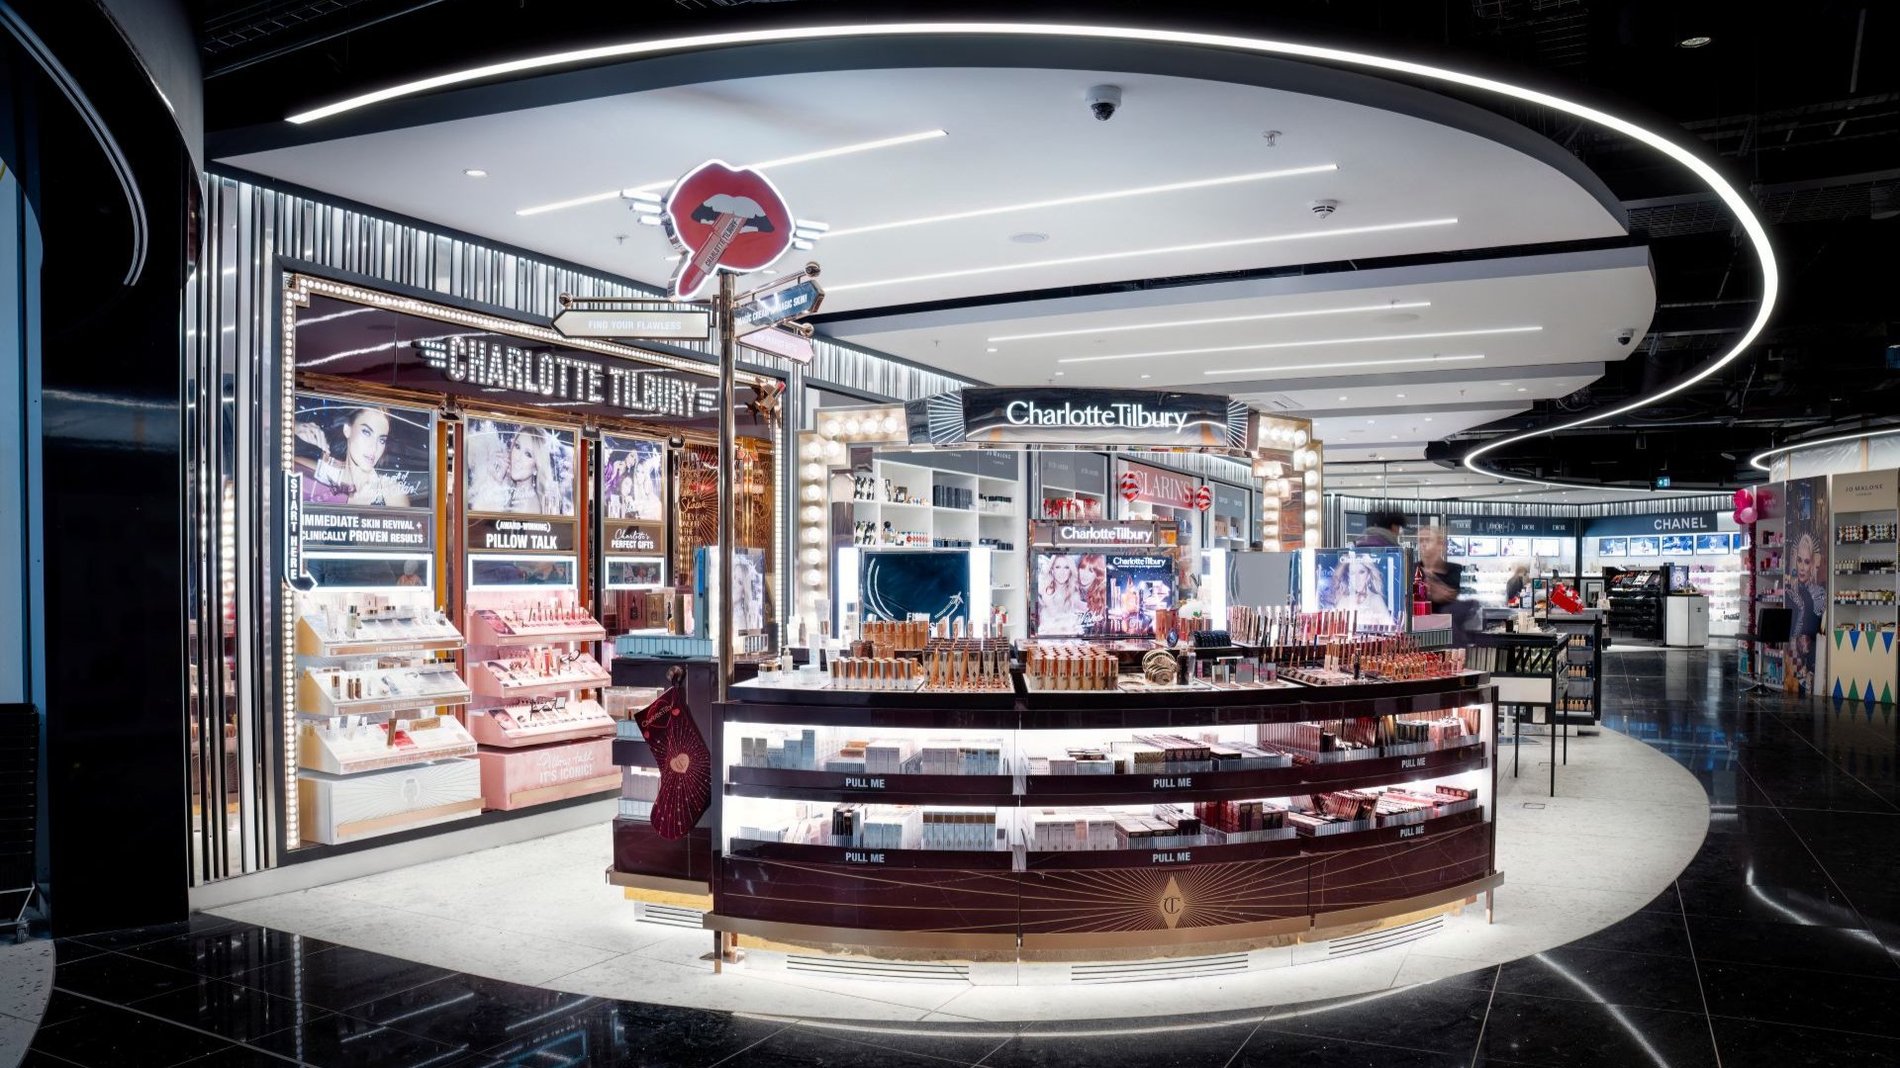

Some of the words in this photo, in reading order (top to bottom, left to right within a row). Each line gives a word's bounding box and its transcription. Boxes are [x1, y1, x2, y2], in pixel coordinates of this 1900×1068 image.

[704, 239, 726, 267] CHARLOTTE
[588, 320, 608, 331] FIND
[611, 320, 634, 331] YOUR
[637, 320, 681, 331] FLAWLESS
[446, 335, 604, 403] CHARLOTTE
[608, 366, 698, 418] TILBURY
[1135, 470, 1191, 503] CLARINS
[1854, 483, 1884, 492] MALONE
[290, 478, 298, 532] START
[302, 514, 359, 528] IMMEDIATE
[361, 518, 380, 529] SKIN
[383, 519, 415, 530] REVIVAL
[1521, 523, 1535, 531] DIOR
[1654, 516, 1708, 531] CHANEL
[301, 530, 347, 541] CLINICALLY
[349, 530, 389, 543] PROVEN
[390, 533, 423, 544] RESULTS
[485, 533, 528, 549] PILLOW
[531, 535, 558, 550] TALK
[611, 539, 637, 549] PERFECT
[637, 540, 654, 550] GIFTS
[290, 536, 298, 580] HERE
[1401, 758, 1416, 769] PULL
[1416, 757, 1426, 767] ME
[845, 777, 868, 788] PULL
[870, 778, 886, 789] ME
[1153, 778, 1176, 788] PULL
[1177, 777, 1192, 788] ME
[1400, 827, 1414, 838] PULL
[1415, 825, 1425, 835] ME
[845, 851, 868, 862] PULL
[870, 853, 885, 863] ME
[1152, 852, 1175, 863] PULL
[1177, 851, 1191, 862] ME
